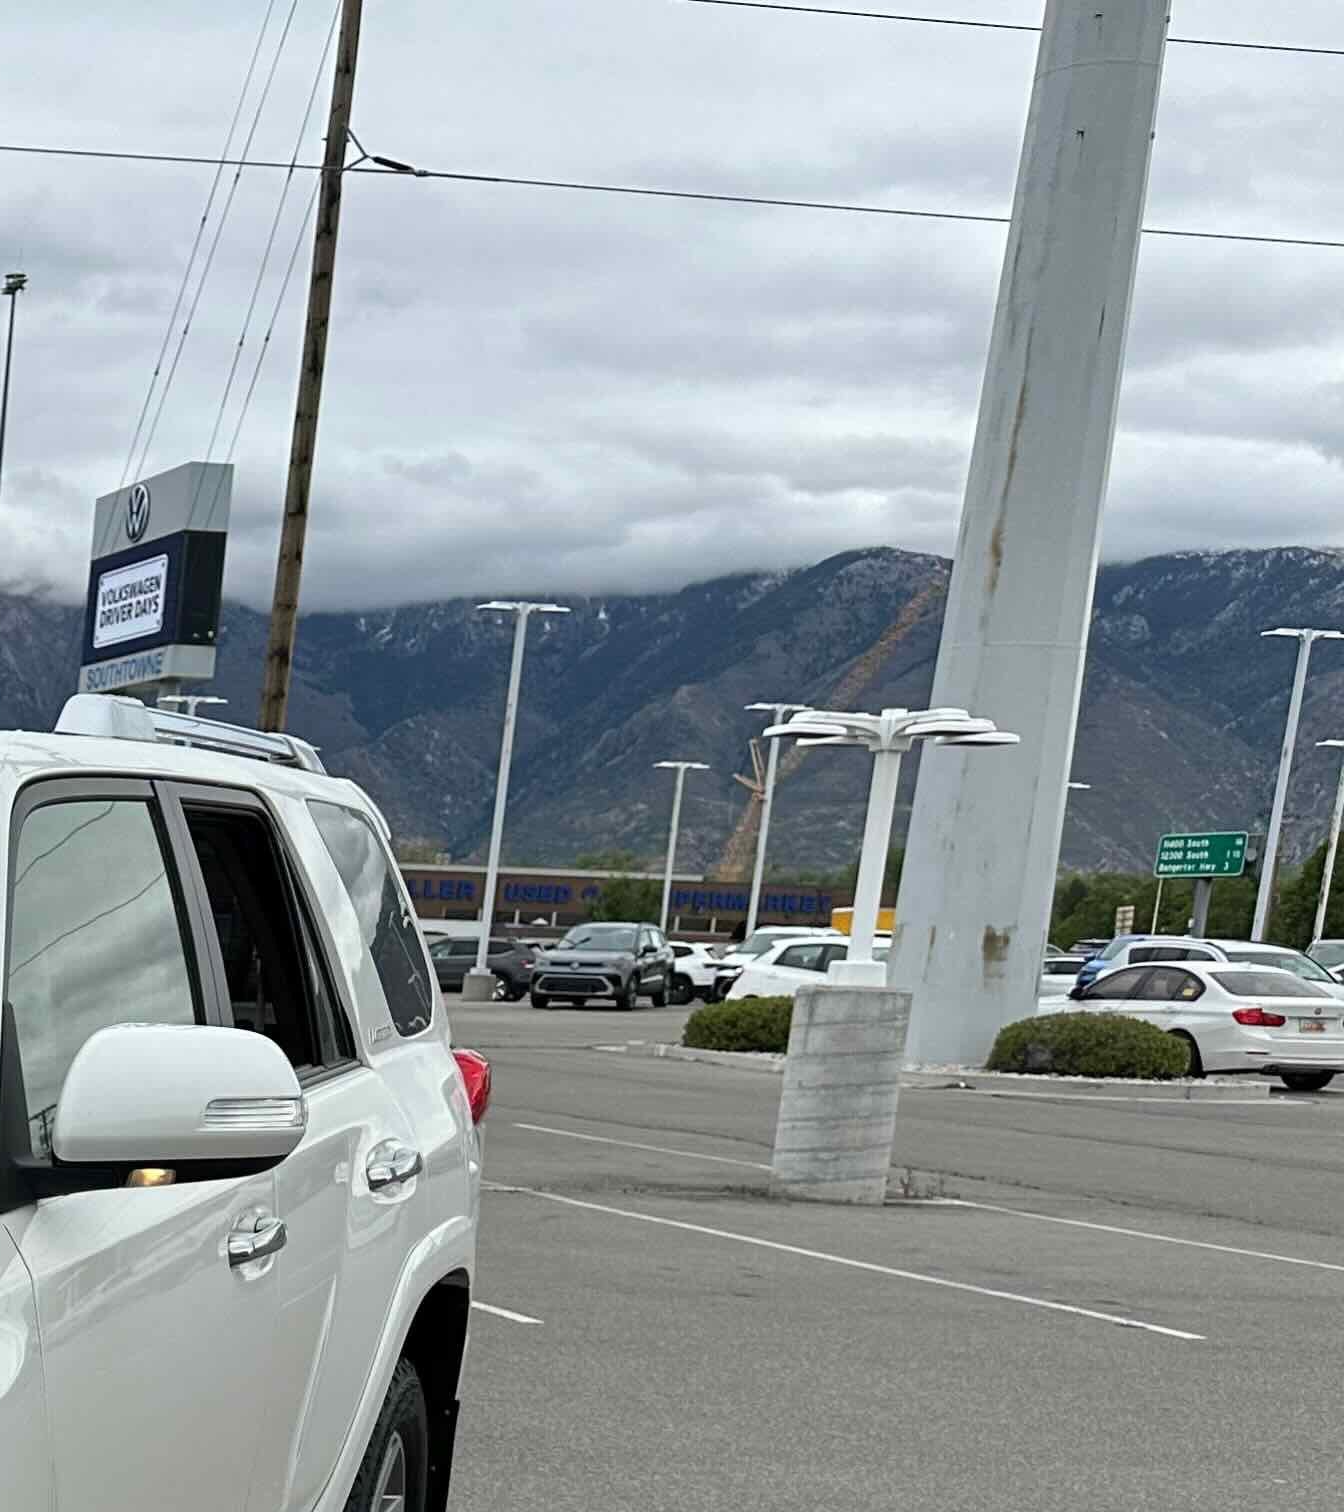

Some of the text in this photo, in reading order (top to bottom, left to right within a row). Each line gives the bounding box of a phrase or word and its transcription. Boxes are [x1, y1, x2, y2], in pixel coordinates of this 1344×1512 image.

[100, 574, 161, 607] VOLKSWAGEN
[99, 594, 160, 629] DRIVER DAYS
[87, 653, 162, 690] SOUTHTOWNE
[1185, 850, 1209, 859] South
